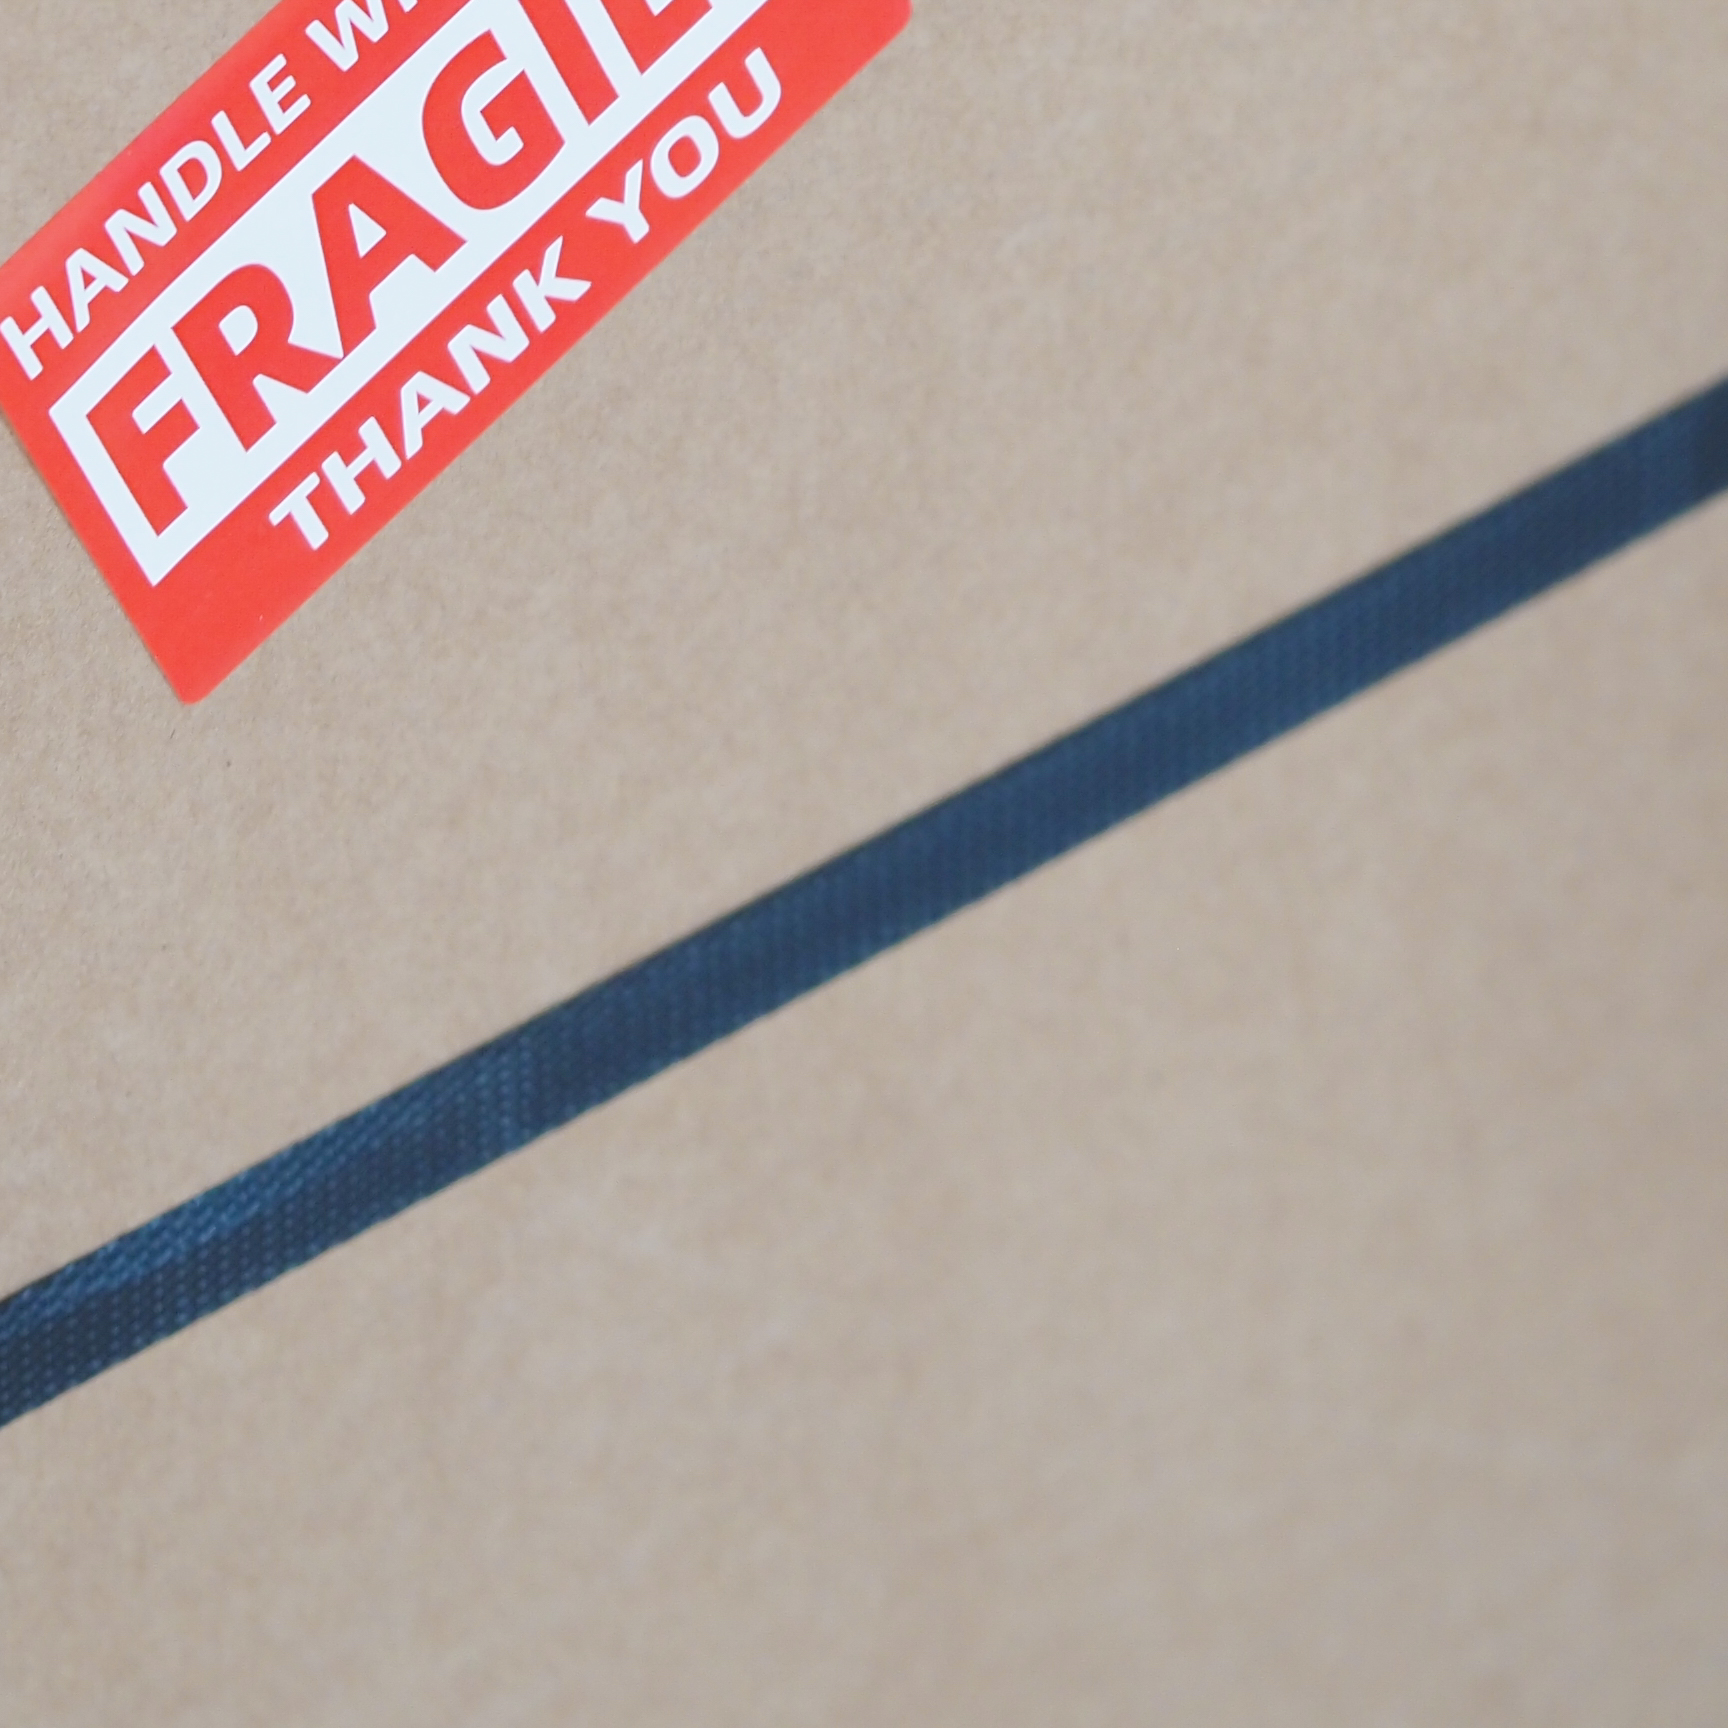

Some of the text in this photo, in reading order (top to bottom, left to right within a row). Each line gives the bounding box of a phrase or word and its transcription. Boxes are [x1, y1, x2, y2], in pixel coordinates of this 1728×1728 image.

[0, 53, 312, 380] HANDLE
[268, 47, 781, 551] THANK YOU
